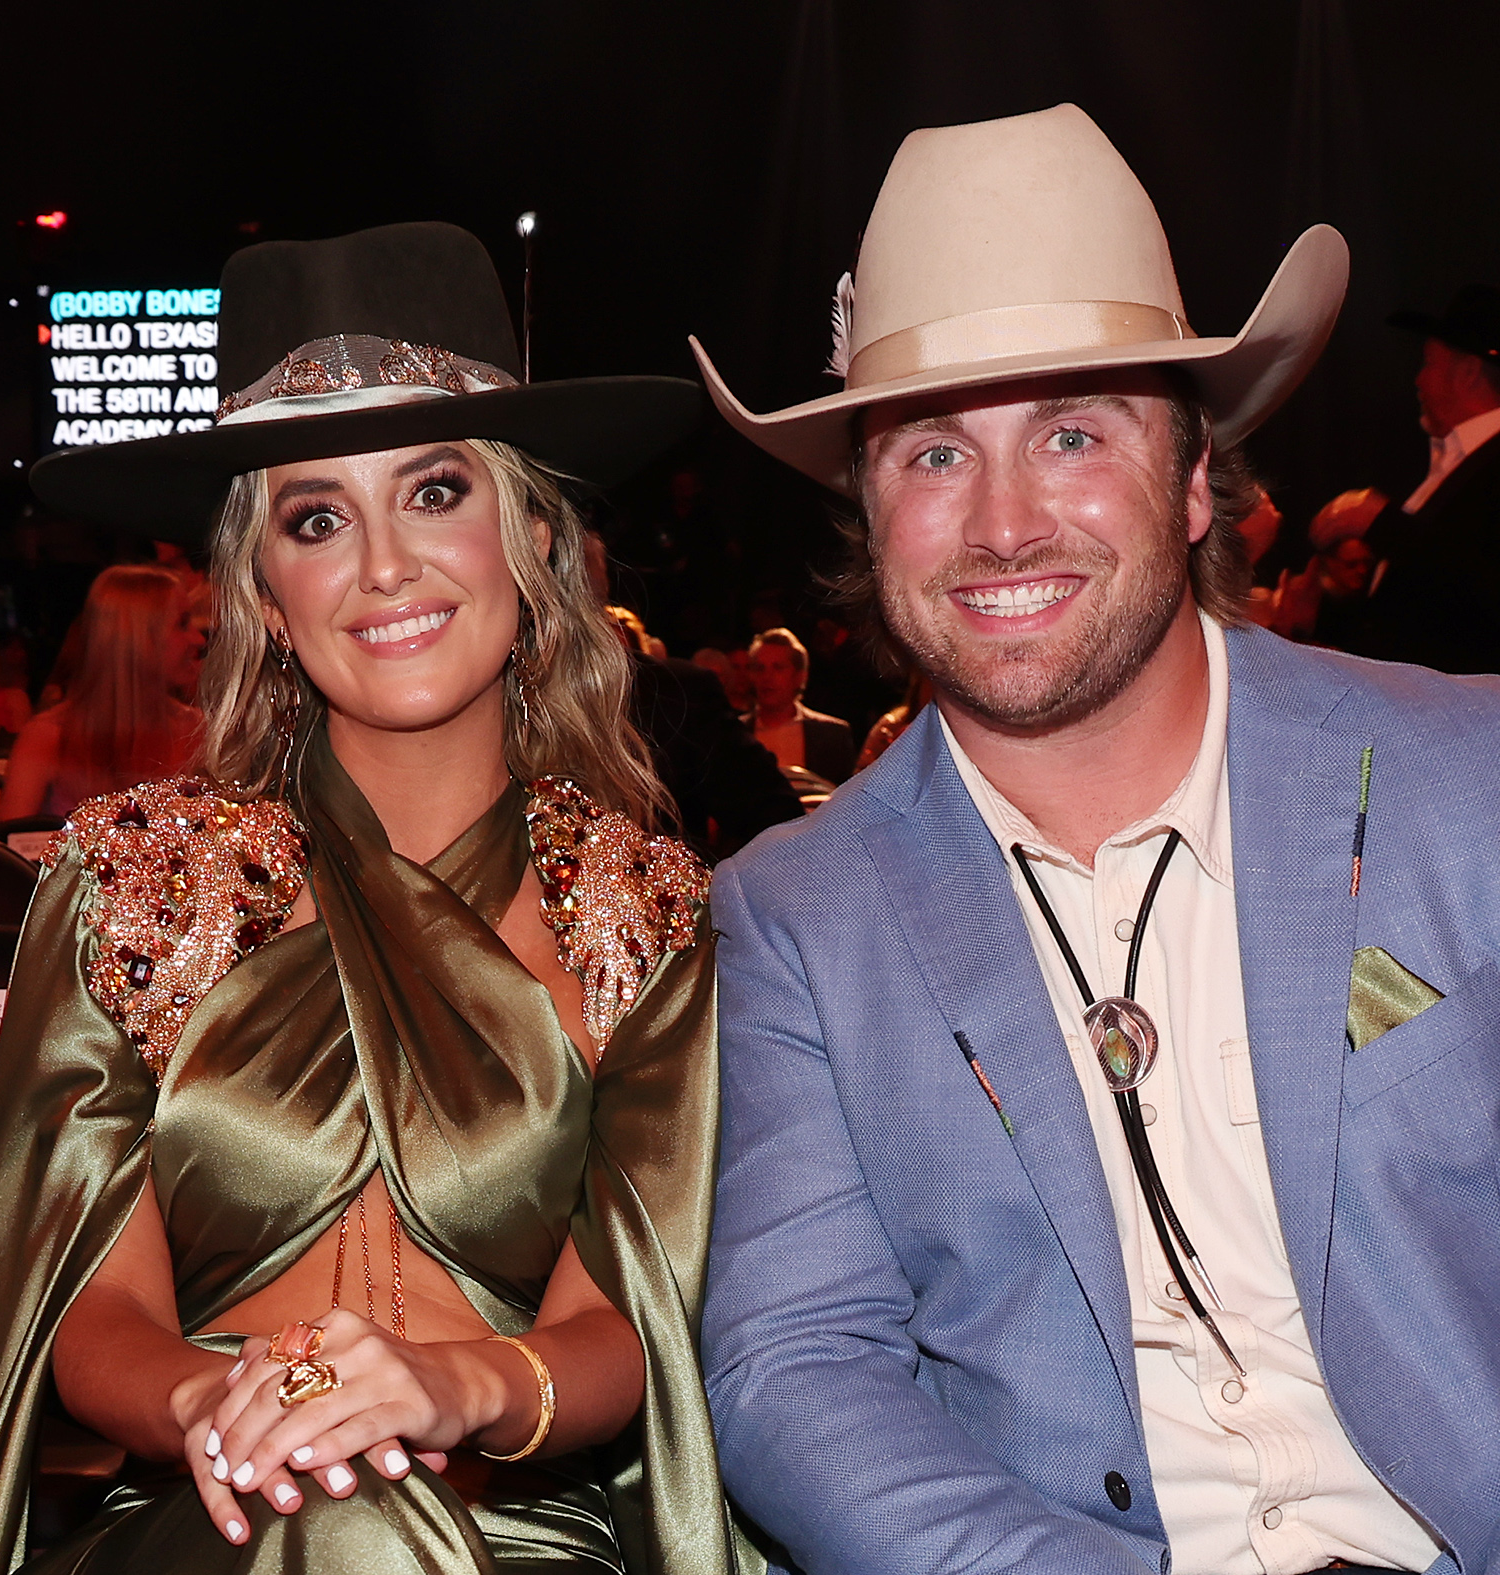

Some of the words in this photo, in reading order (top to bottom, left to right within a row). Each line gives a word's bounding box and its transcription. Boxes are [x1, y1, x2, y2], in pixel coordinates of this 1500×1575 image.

[50, 290, 143, 323] (BOBBY
[50, 322, 132, 350] HELLO
[50, 354, 179, 382] WELCOME
[179, 353, 218, 381] TO
[51, 387, 104, 414] THE
[105, 386, 172, 414] 58TH
[52, 418, 174, 445] ACADEMY
